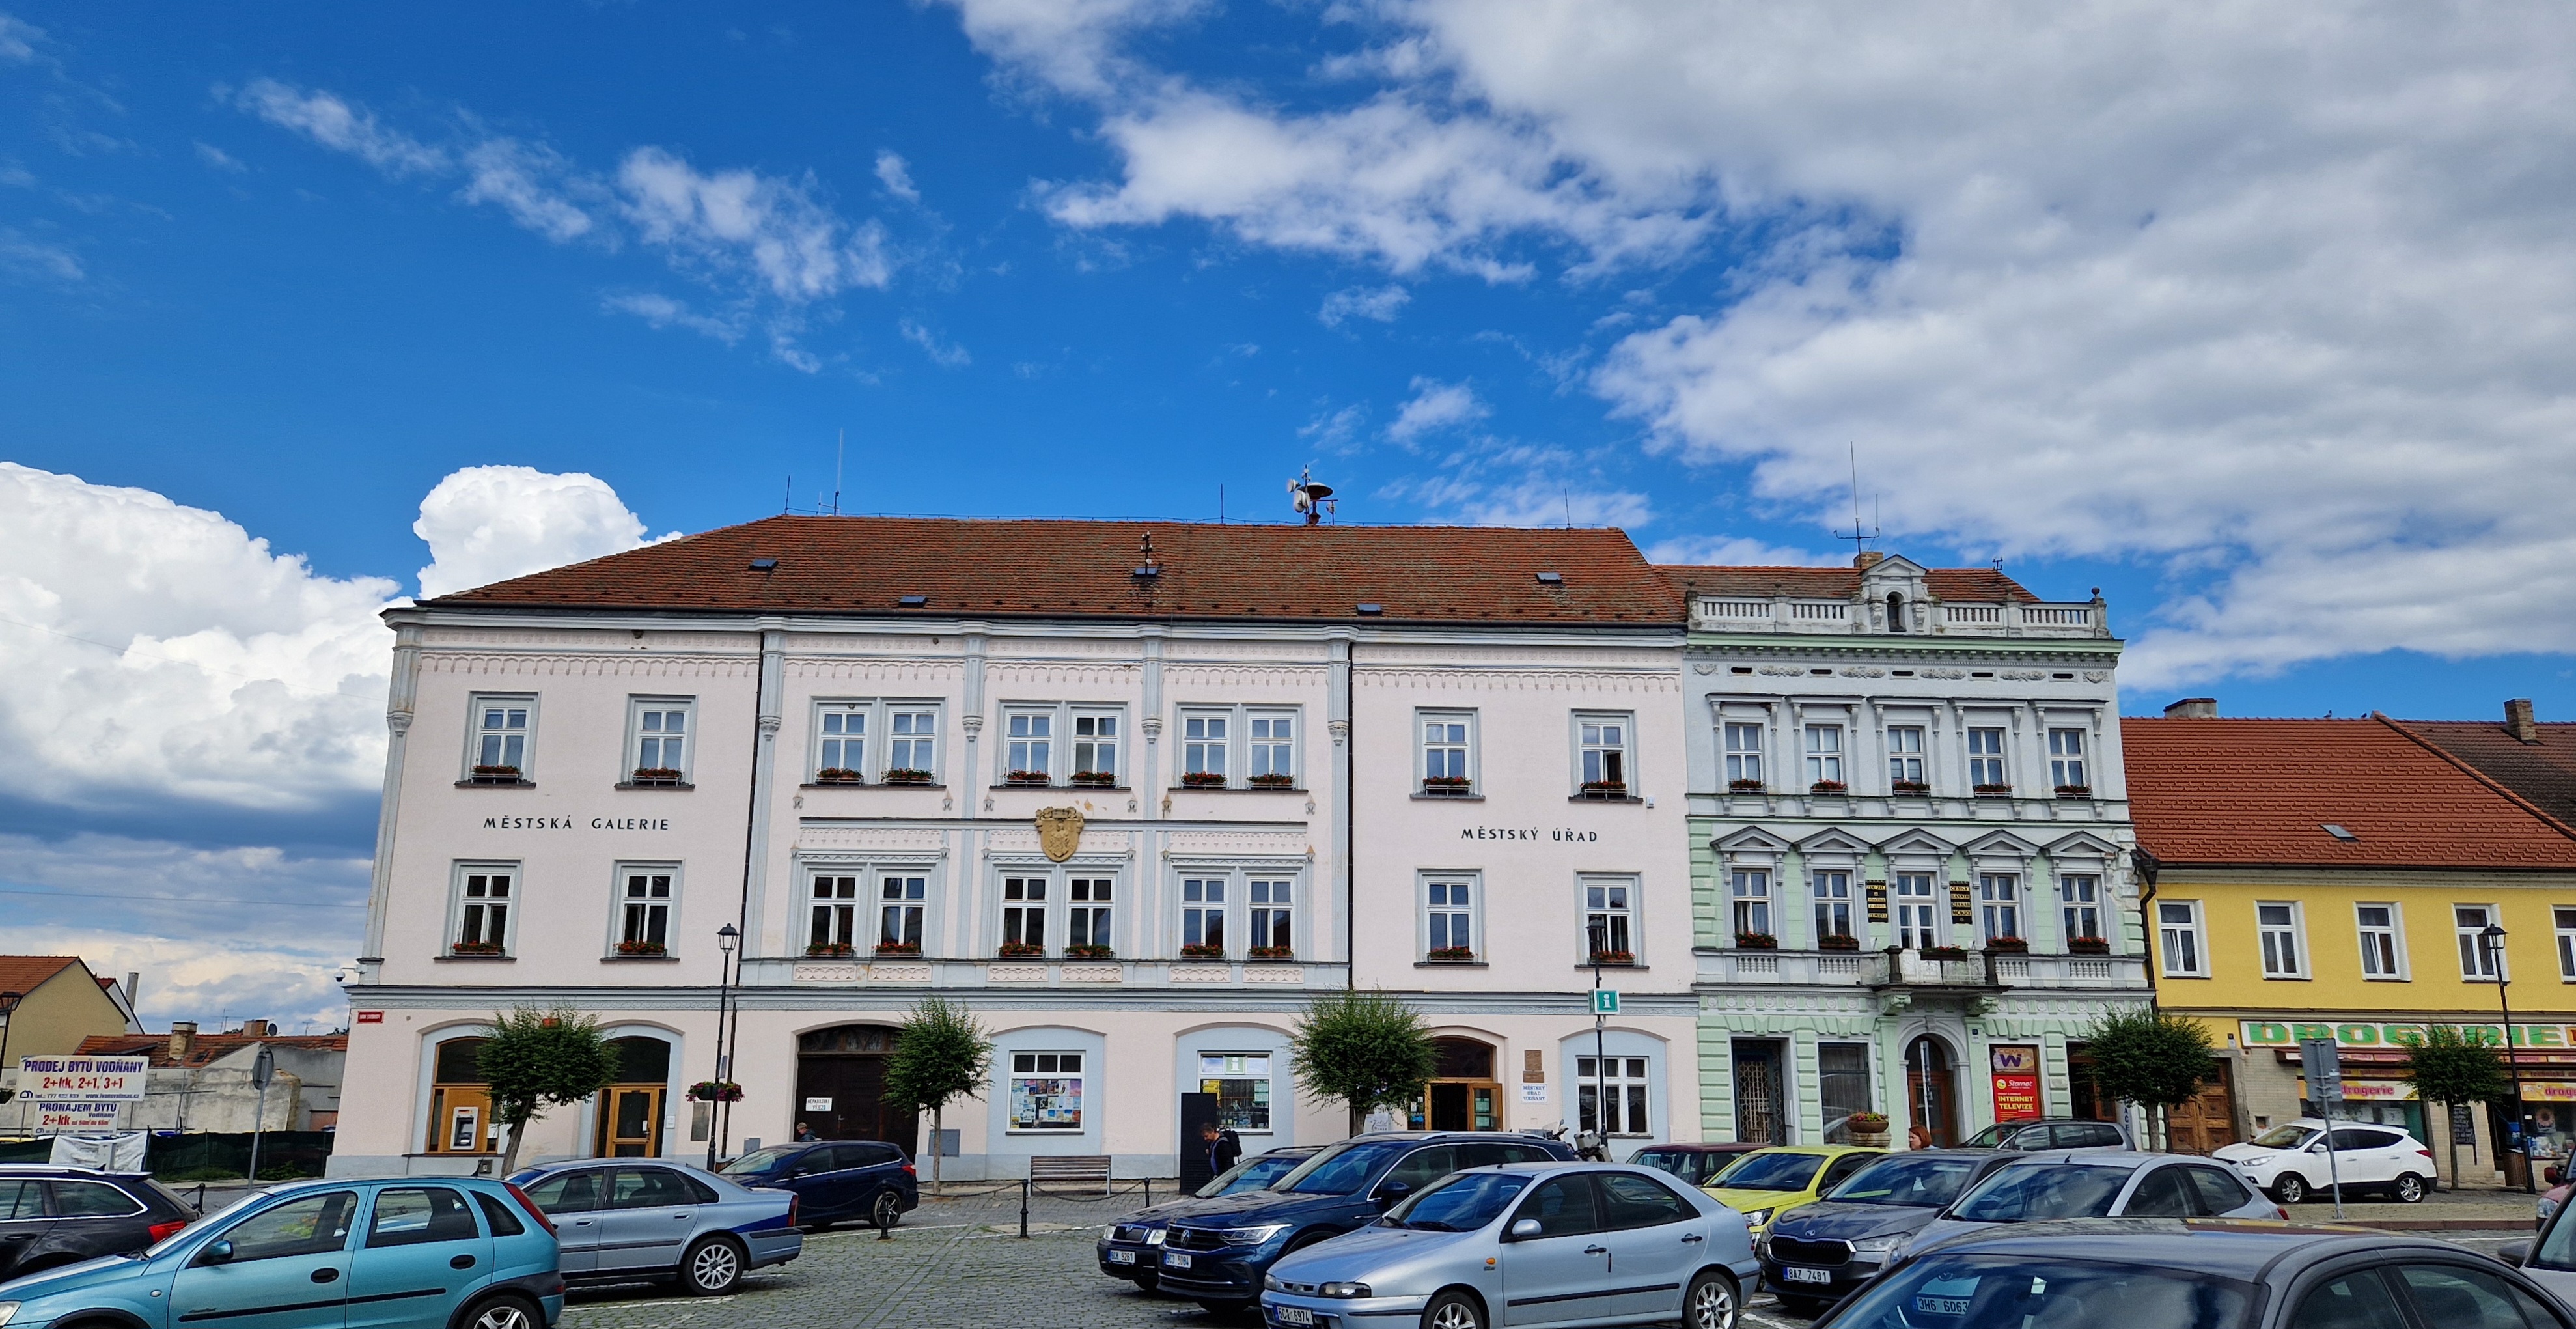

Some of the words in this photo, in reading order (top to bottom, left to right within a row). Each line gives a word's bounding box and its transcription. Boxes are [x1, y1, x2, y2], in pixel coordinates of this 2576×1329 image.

[483, 815, 572, 829] MĚSTSKÁ
[591, 818, 669, 830] GALERIE
[1461, 826, 1538, 840] MĚSTSKÝ
[1552, 828, 1597, 841] ÚŘAD
[24, 1061, 65, 1072] PRODEJ
[68, 1058, 92, 1072] BYTŮ
[96, 1059, 143, 1073] VODŇANY
[43, 1077, 74, 1090] 2+kk,
[77, 1077, 100, 1090] 2+1,
[104, 1077, 124, 1088] 3+1
[2341, 1085, 2394, 1097] drogerie
[2545, 1087, 2576, 1098] drog
[42, 1115, 70, 1126] 2+kk
[1788, 1268, 1802, 1280] 8AZ
[1807, 1270, 1827, 1281] 7481
[1919, 1298, 1937, 1311] 3H6
[1944, 1300, 1969, 1313] 6063
[1279, 1308, 1290, 1321] 5C1
[1293, 1309, 1310, 1322] 6974
